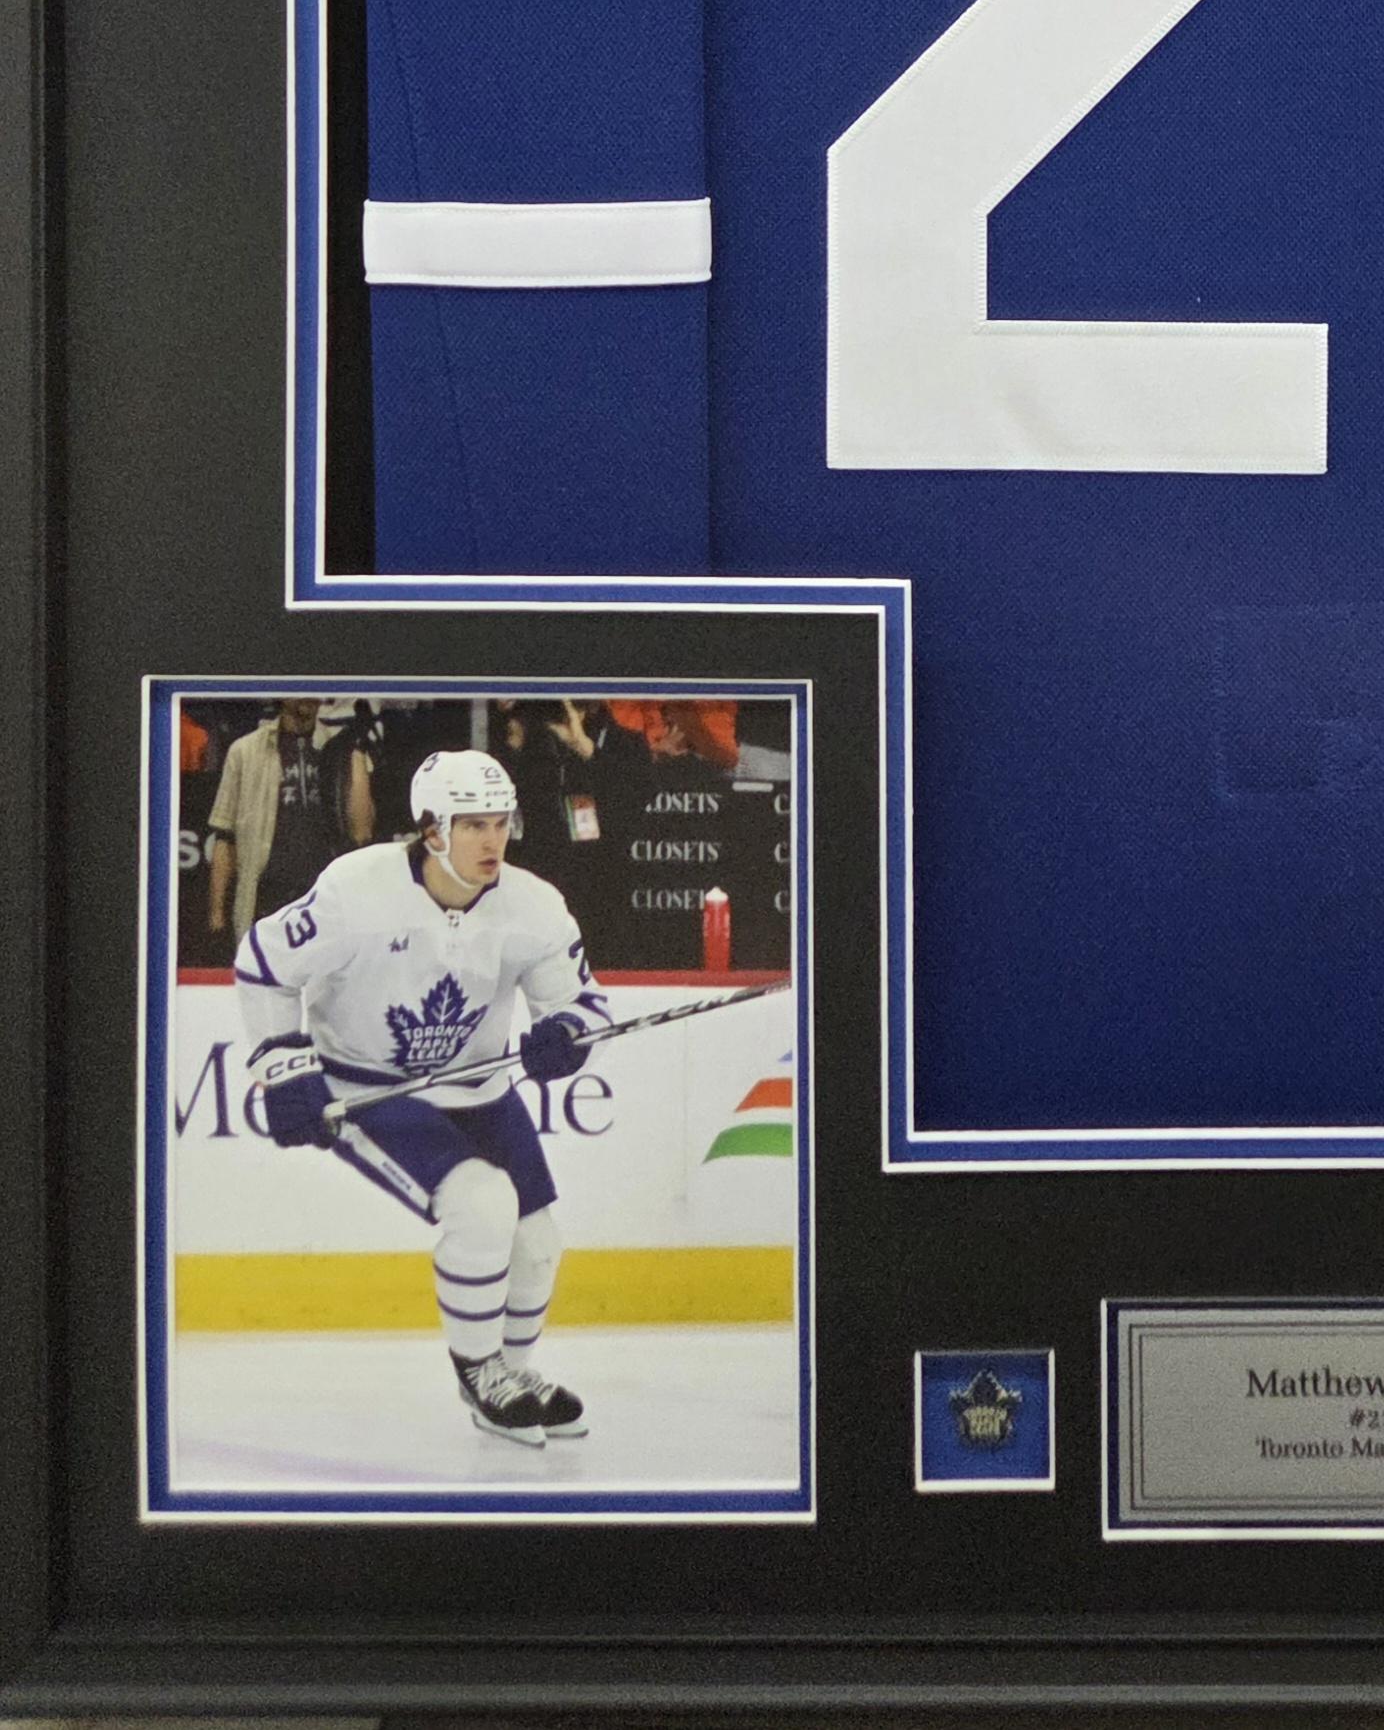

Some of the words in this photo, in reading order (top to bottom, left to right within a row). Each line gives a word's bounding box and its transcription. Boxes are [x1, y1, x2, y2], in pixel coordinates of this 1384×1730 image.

[630, 839, 722, 863] CLOSETS
[630, 888, 706, 911] CLOSET
[402, 1024, 472, 1042] TORONTO
[410, 1037, 458, 1050] MAPLE
[1255, 1436, 1345, 1460] Toronto
